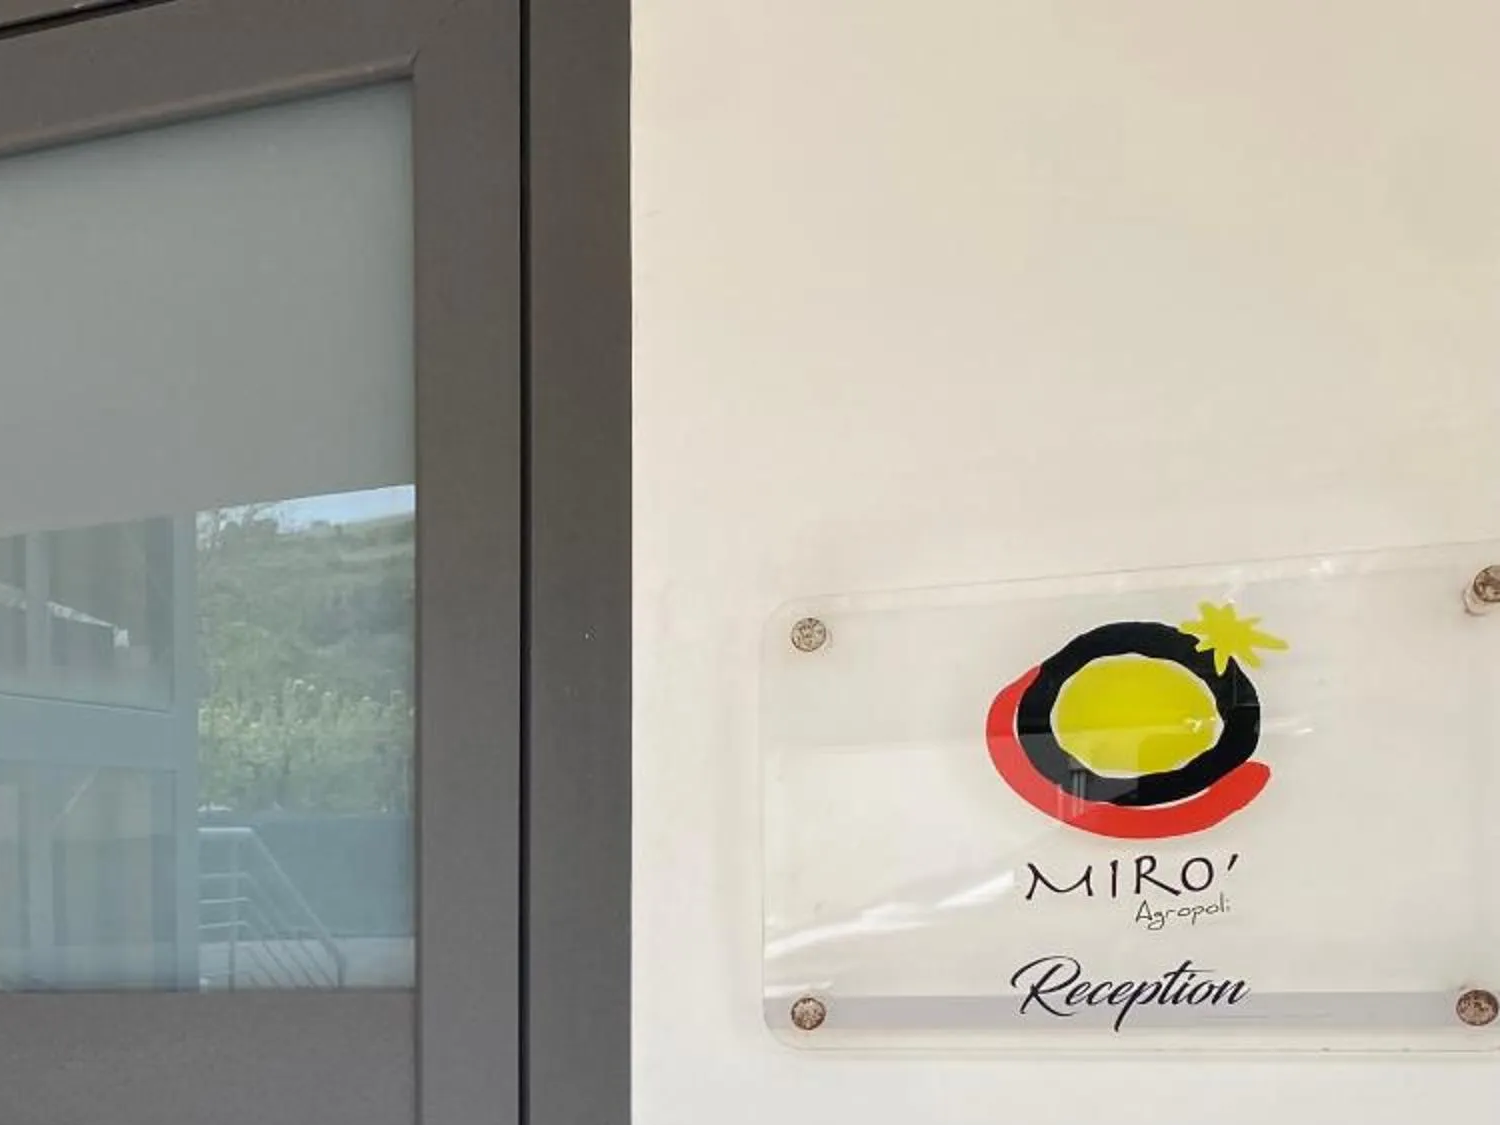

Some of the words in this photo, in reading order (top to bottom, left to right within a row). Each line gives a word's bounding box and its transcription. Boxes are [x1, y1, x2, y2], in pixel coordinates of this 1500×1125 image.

[1025, 853, 1239, 900] MIRO'
[1135, 892, 1231, 930] Agropoli
[1010, 955, 1250, 1032] Reception
